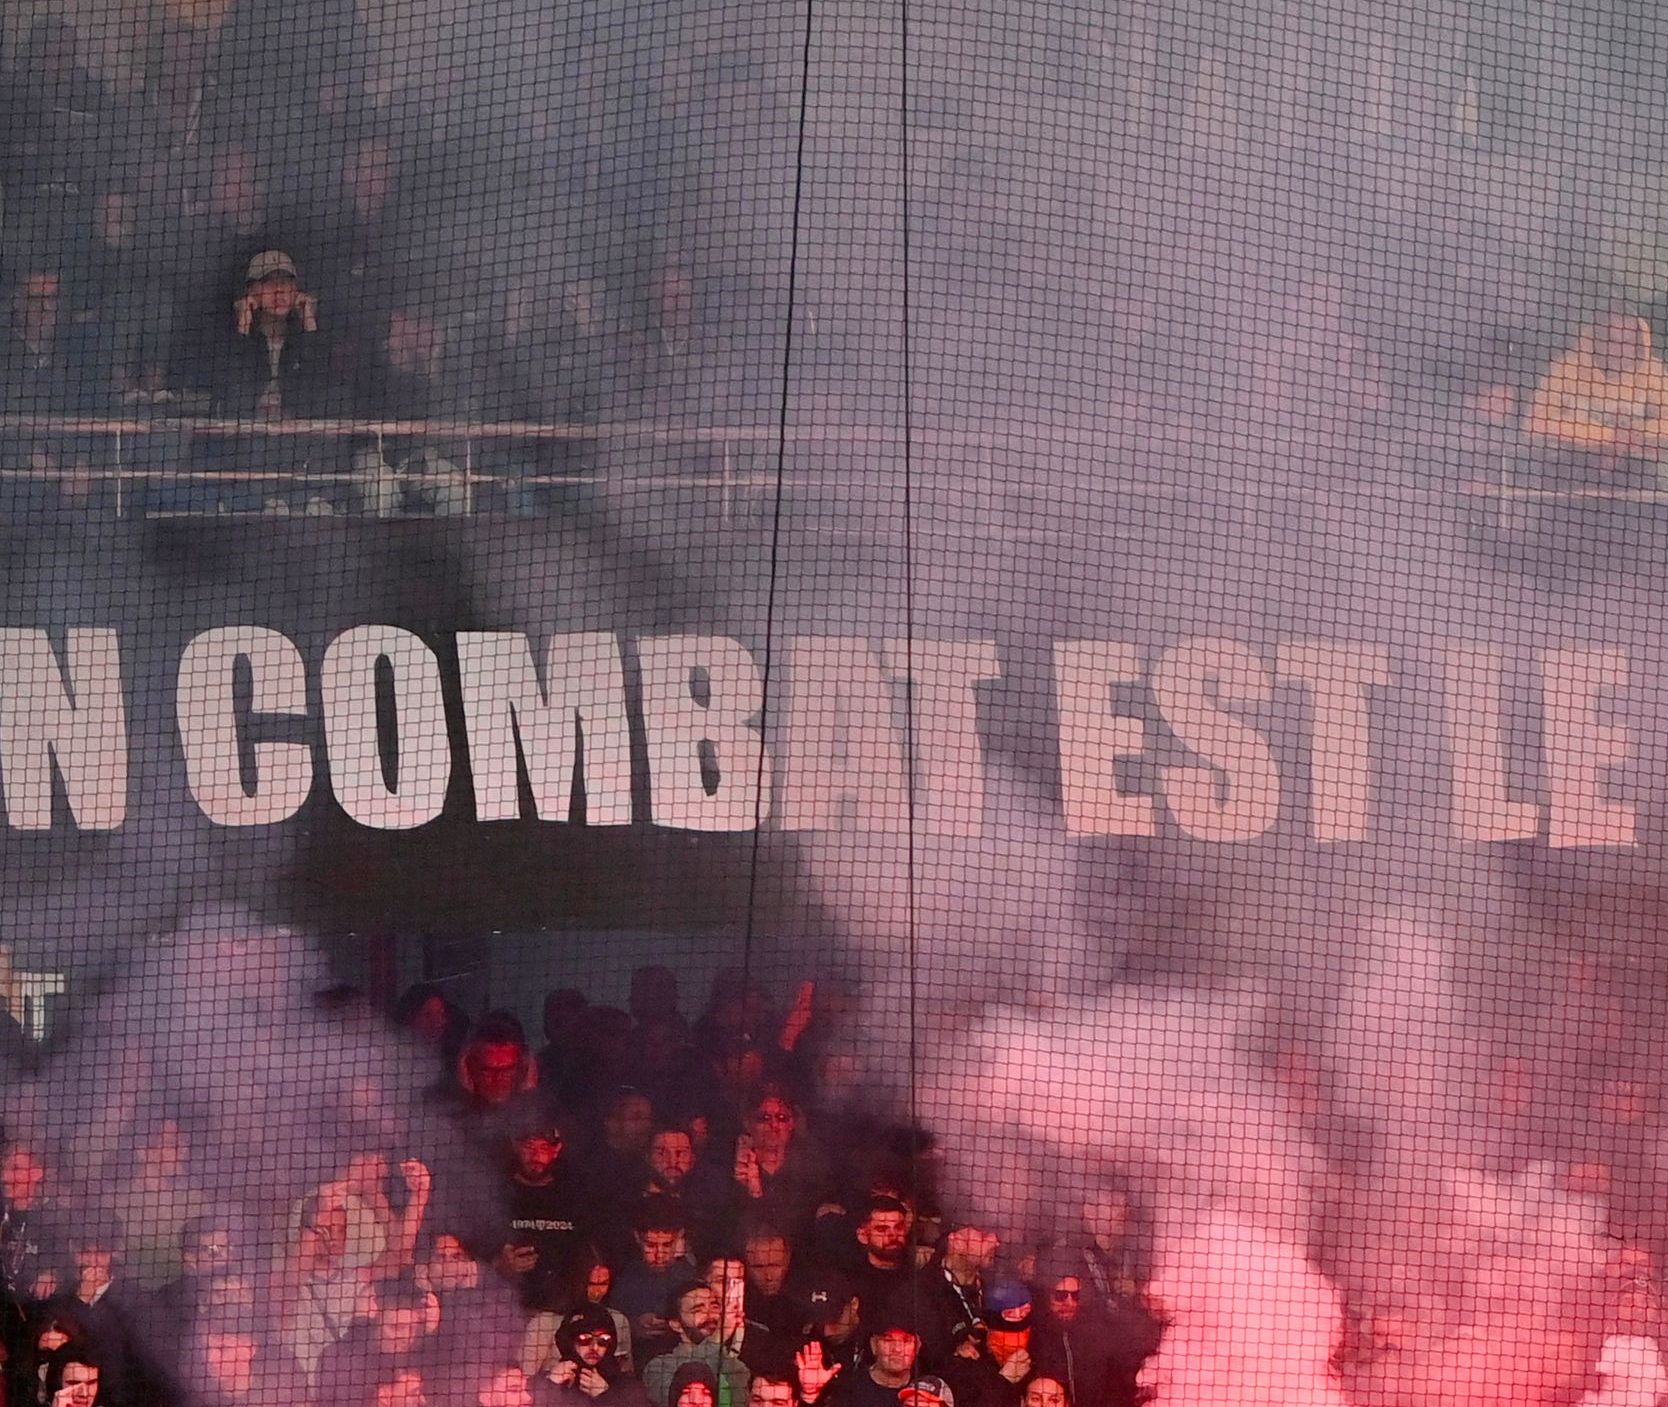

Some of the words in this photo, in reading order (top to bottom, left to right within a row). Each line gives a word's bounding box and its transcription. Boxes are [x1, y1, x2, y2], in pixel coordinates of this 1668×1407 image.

[175, 623, 1001, 832] COMBAT
[1053, 636, 1391, 846] EST
[1442, 645, 1638, 848] LE
